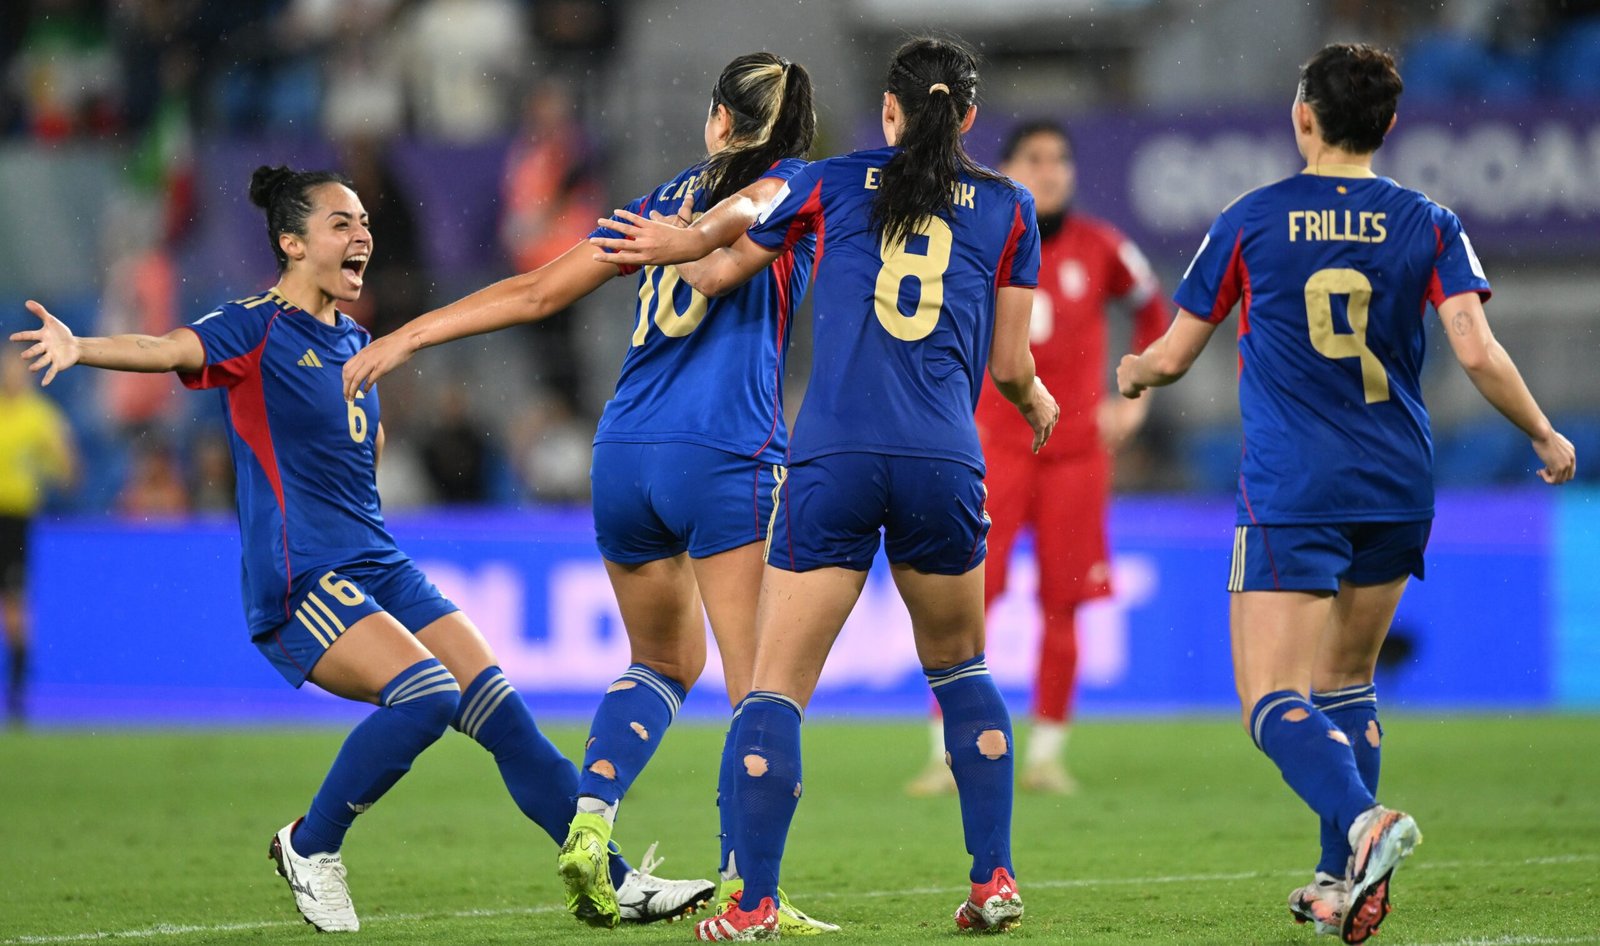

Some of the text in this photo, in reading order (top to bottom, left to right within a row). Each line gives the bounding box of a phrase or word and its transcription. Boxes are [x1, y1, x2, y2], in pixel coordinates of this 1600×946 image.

[1288, 210, 1387, 243] FRILLES
[874, 214, 953, 342] 8
[1304, 268, 1390, 404] 9
[347, 389, 368, 444] 6
[318, 570, 366, 607] 6
